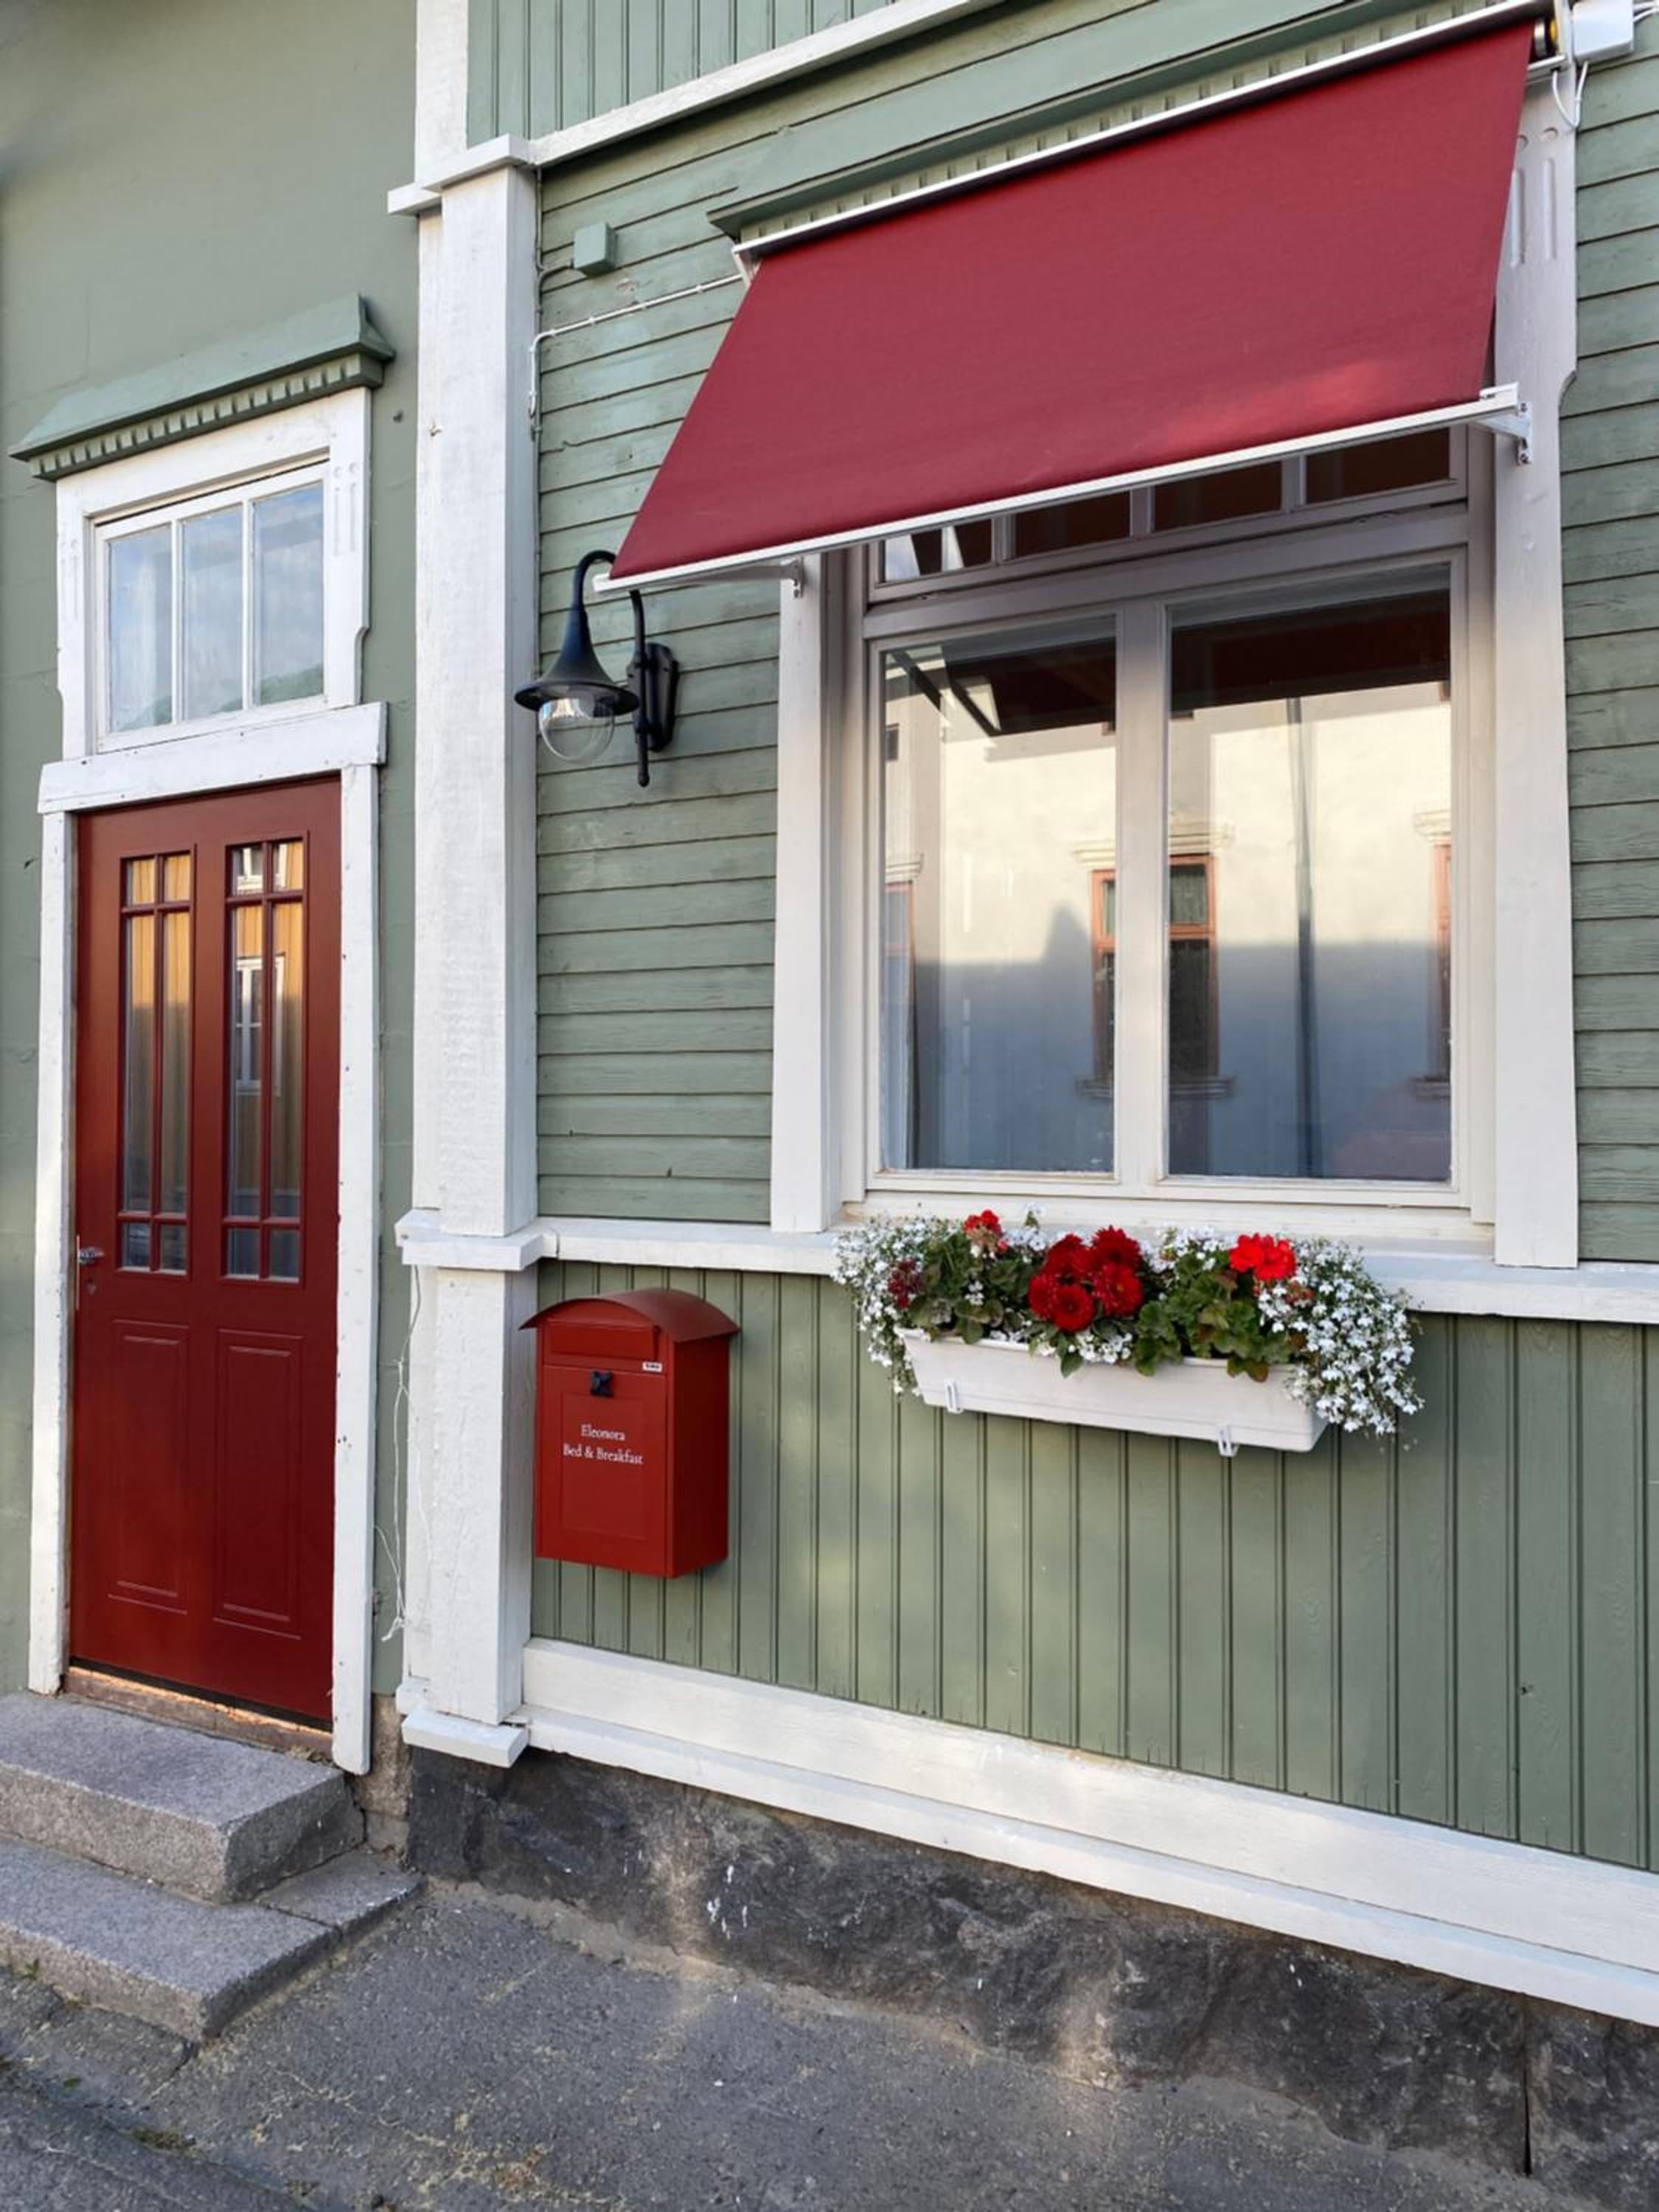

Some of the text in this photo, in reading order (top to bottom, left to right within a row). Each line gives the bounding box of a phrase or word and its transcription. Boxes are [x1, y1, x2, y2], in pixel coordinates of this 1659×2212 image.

[581, 1423, 625, 1441] Eleonora
[563, 1443, 643, 1464] Bed & Breakfast
